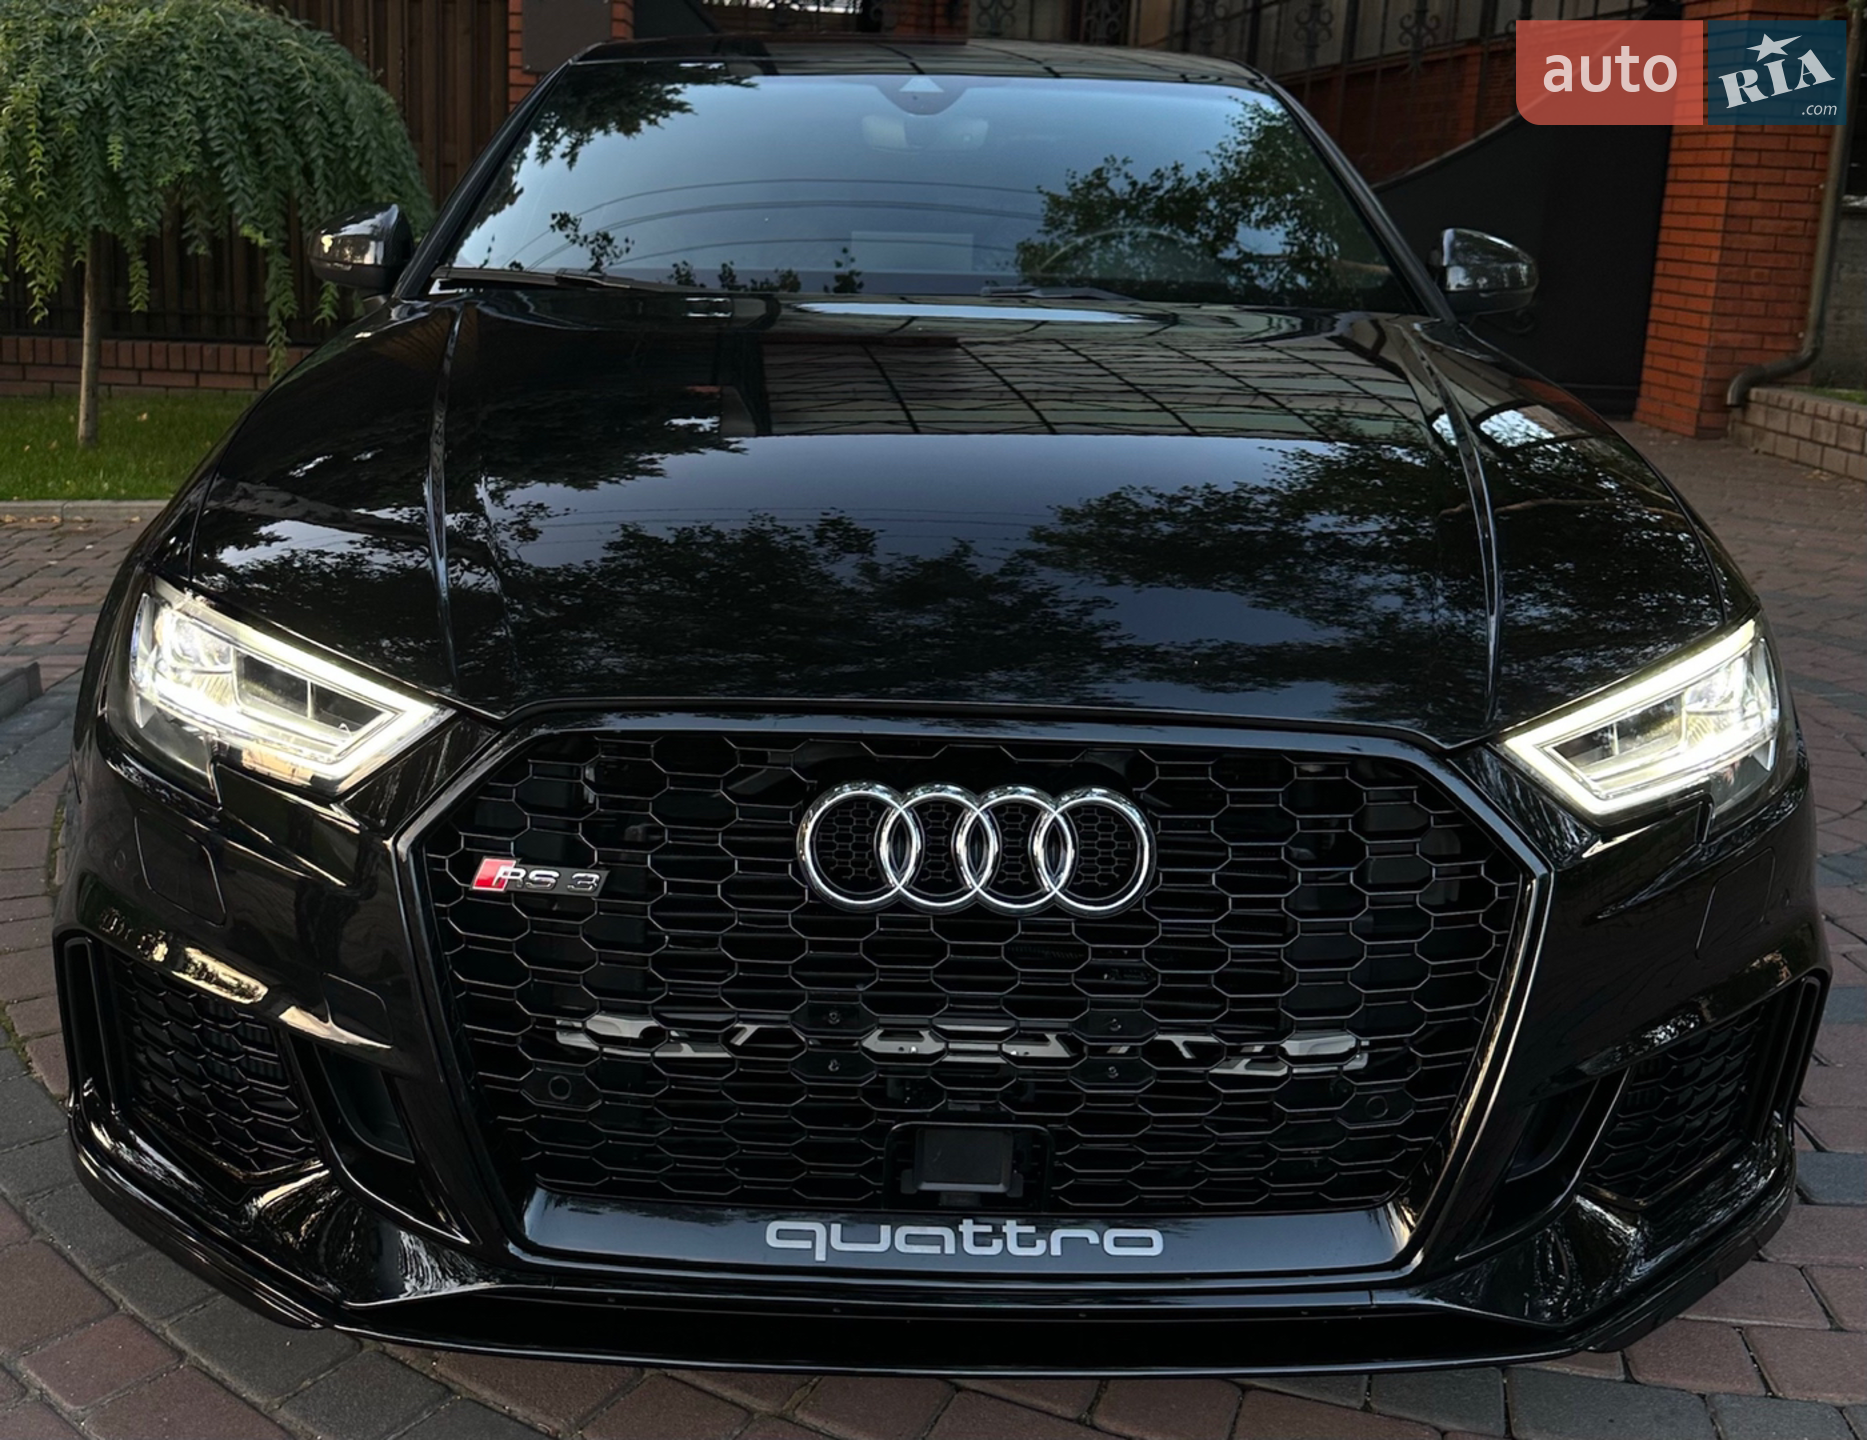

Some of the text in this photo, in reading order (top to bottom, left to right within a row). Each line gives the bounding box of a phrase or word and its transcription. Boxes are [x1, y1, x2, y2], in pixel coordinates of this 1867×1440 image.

[491, 866, 601, 892] RS 3
[765, 1218, 1164, 1262] quattro
